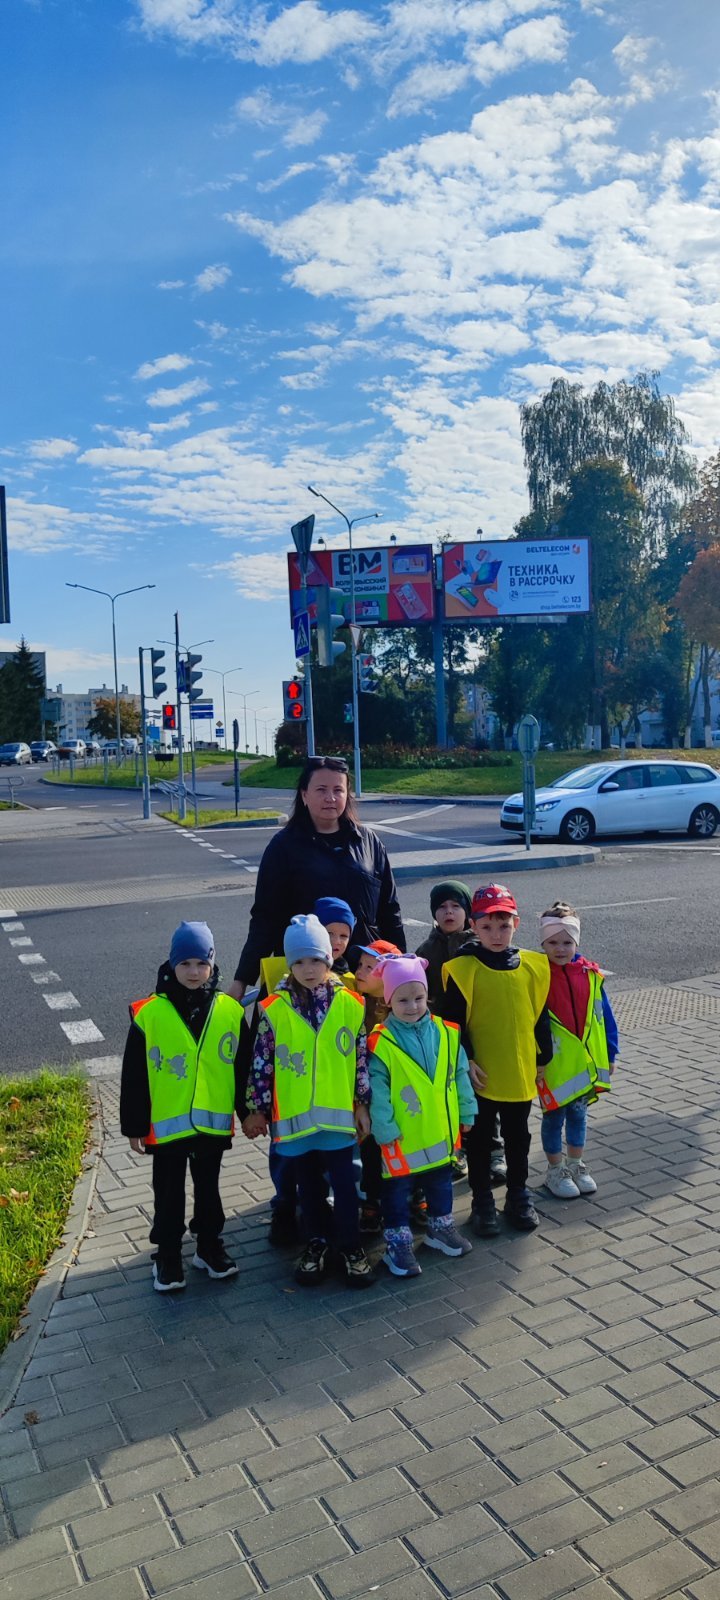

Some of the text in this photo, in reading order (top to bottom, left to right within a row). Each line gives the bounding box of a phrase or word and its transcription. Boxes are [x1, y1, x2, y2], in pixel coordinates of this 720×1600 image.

[526, 545, 570, 553] BELTELECOM
[508, 564, 559, 576] ТЕХНИКА
[336, 577, 386, 586] ВОЛВЫССКИЙ
[510, 575, 575, 586] В РАССРОЧКУ
[293, 703, 303, 718] 2
